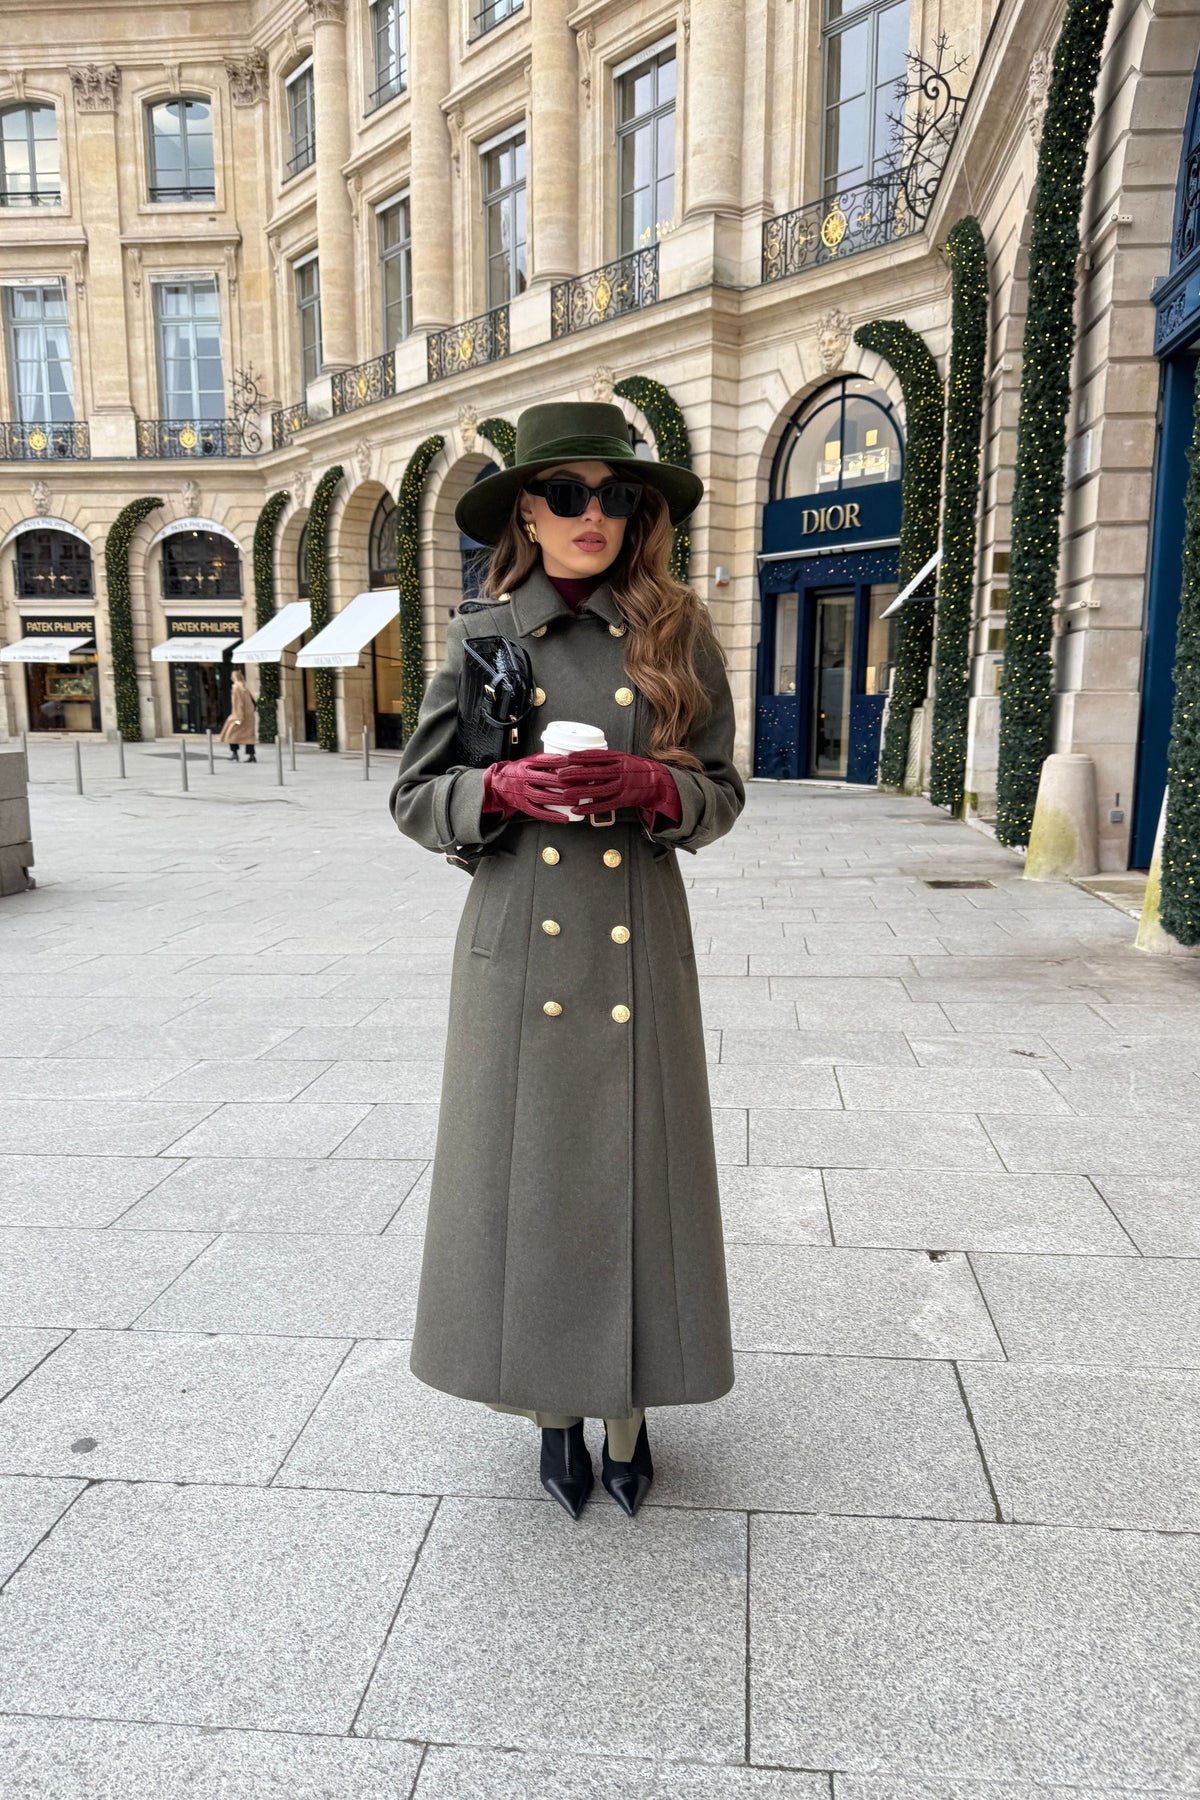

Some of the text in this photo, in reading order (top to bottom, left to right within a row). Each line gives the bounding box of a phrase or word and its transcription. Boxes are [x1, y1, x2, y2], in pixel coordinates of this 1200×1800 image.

[801, 503, 861, 535] DIOR
[26, 621, 93, 632] PATEK PHILIPPE
[171, 621, 240, 632] PATEK PHILIPPE
